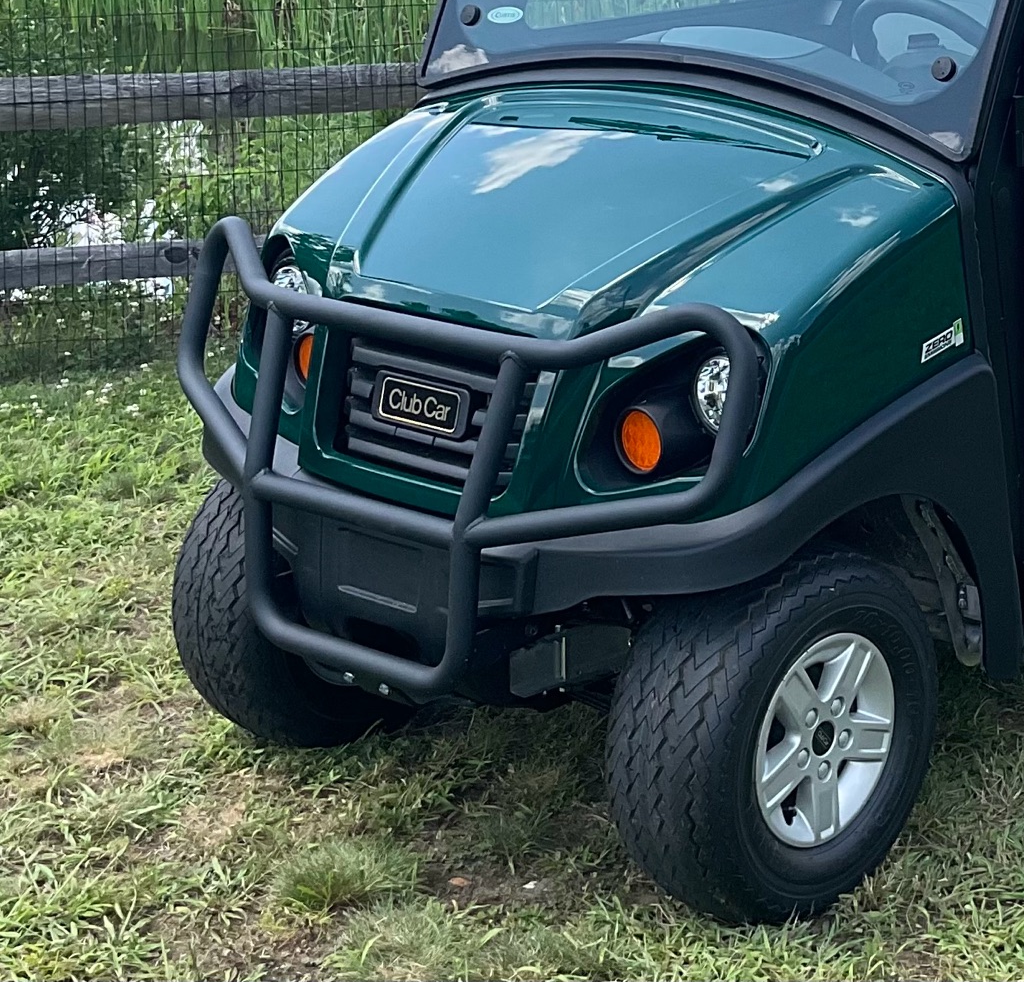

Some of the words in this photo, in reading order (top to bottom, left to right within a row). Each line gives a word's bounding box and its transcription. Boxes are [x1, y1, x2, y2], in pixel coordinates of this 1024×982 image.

[925, 330, 954, 354] ZERO
[388, 388, 422, 415] Club
[423, 396, 452, 422] Car
